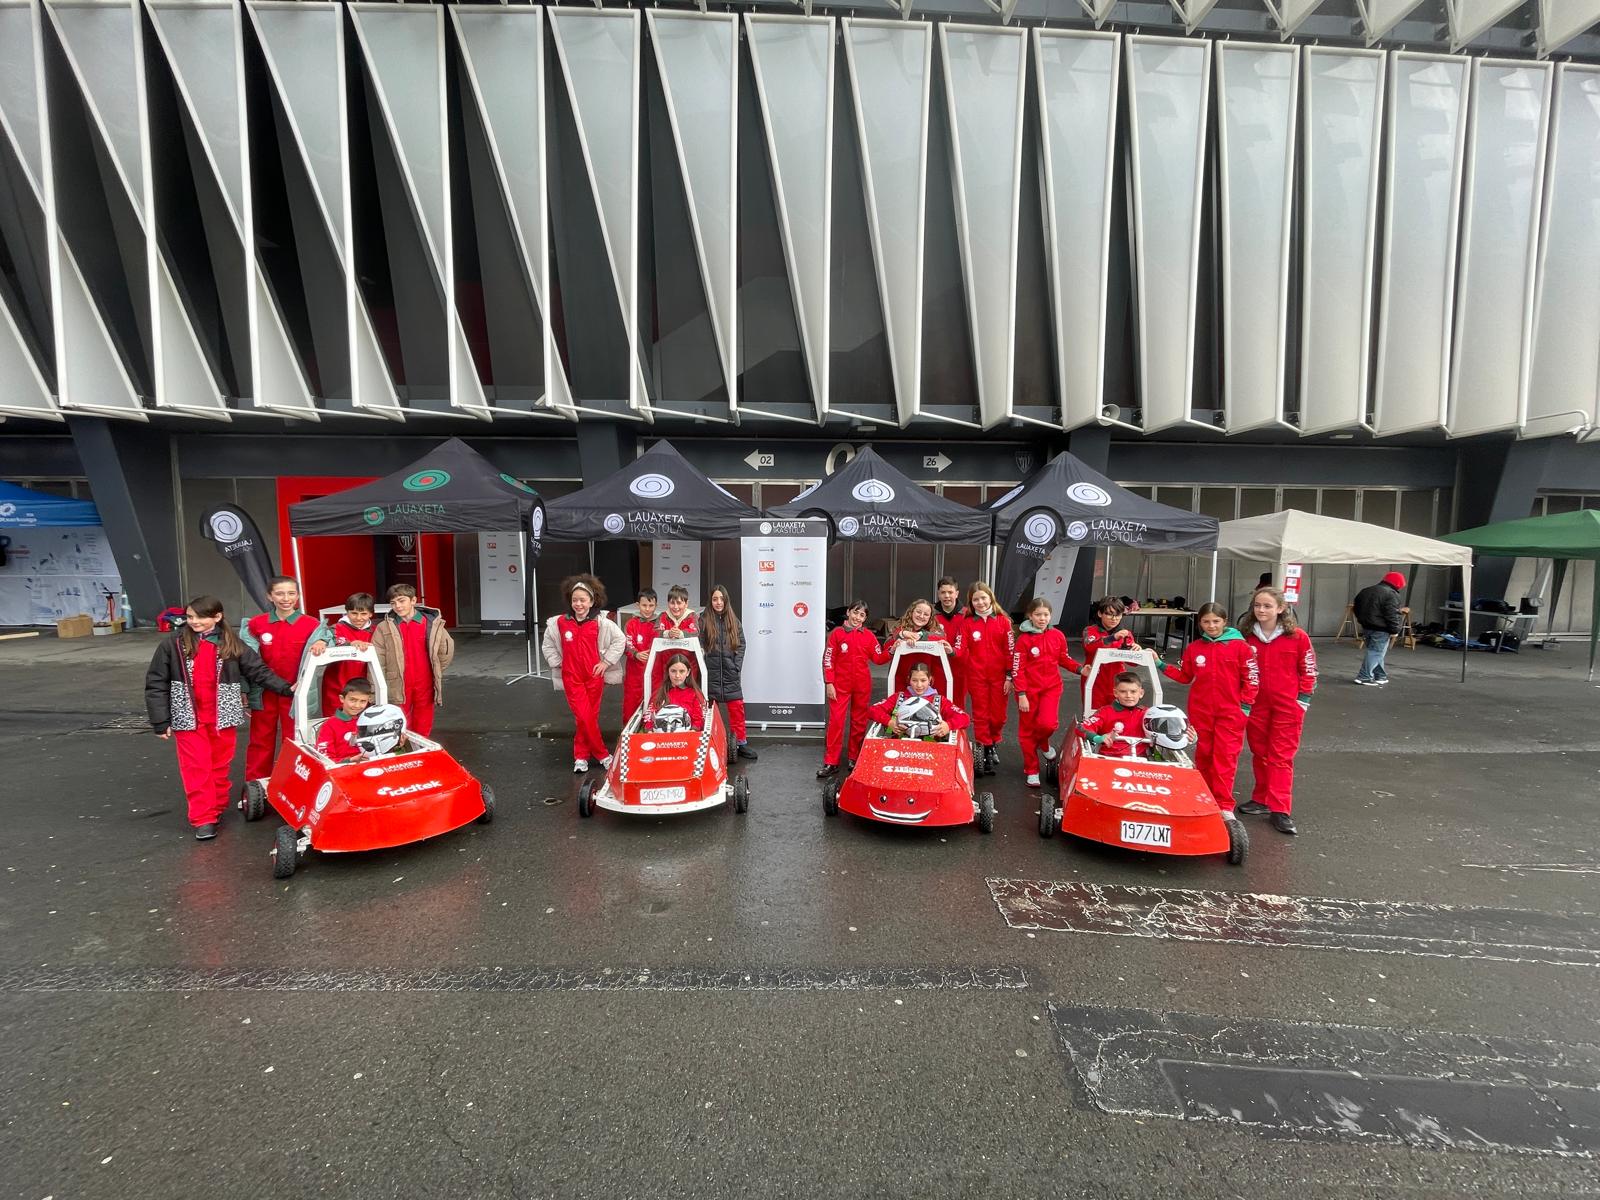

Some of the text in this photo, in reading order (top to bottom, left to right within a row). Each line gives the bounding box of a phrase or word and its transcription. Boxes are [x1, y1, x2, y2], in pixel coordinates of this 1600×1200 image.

[760, 455, 772, 465] 02
[926, 457, 937, 467] 26
[387, 503, 446, 515] LAUAXETA
[628, 511, 686, 524] LAUAXETA
[862, 514, 919, 529] LAUAXETA
[630, 522, 684, 534] IKASTOLA
[772, 521, 807, 529] LAUAXETA
[1091, 519, 1148, 532] LAUAXETA
[864, 526, 917, 538] IKASTOLA
[1093, 530, 1144, 543] IKASTOLA
[1016, 542, 1047, 555] LAUAXETA
[899, 751, 935, 759] LAUAXETA
[1132, 770, 1173, 778] LAUAXETA
[1122, 822, 1171, 843] 1977LXT
